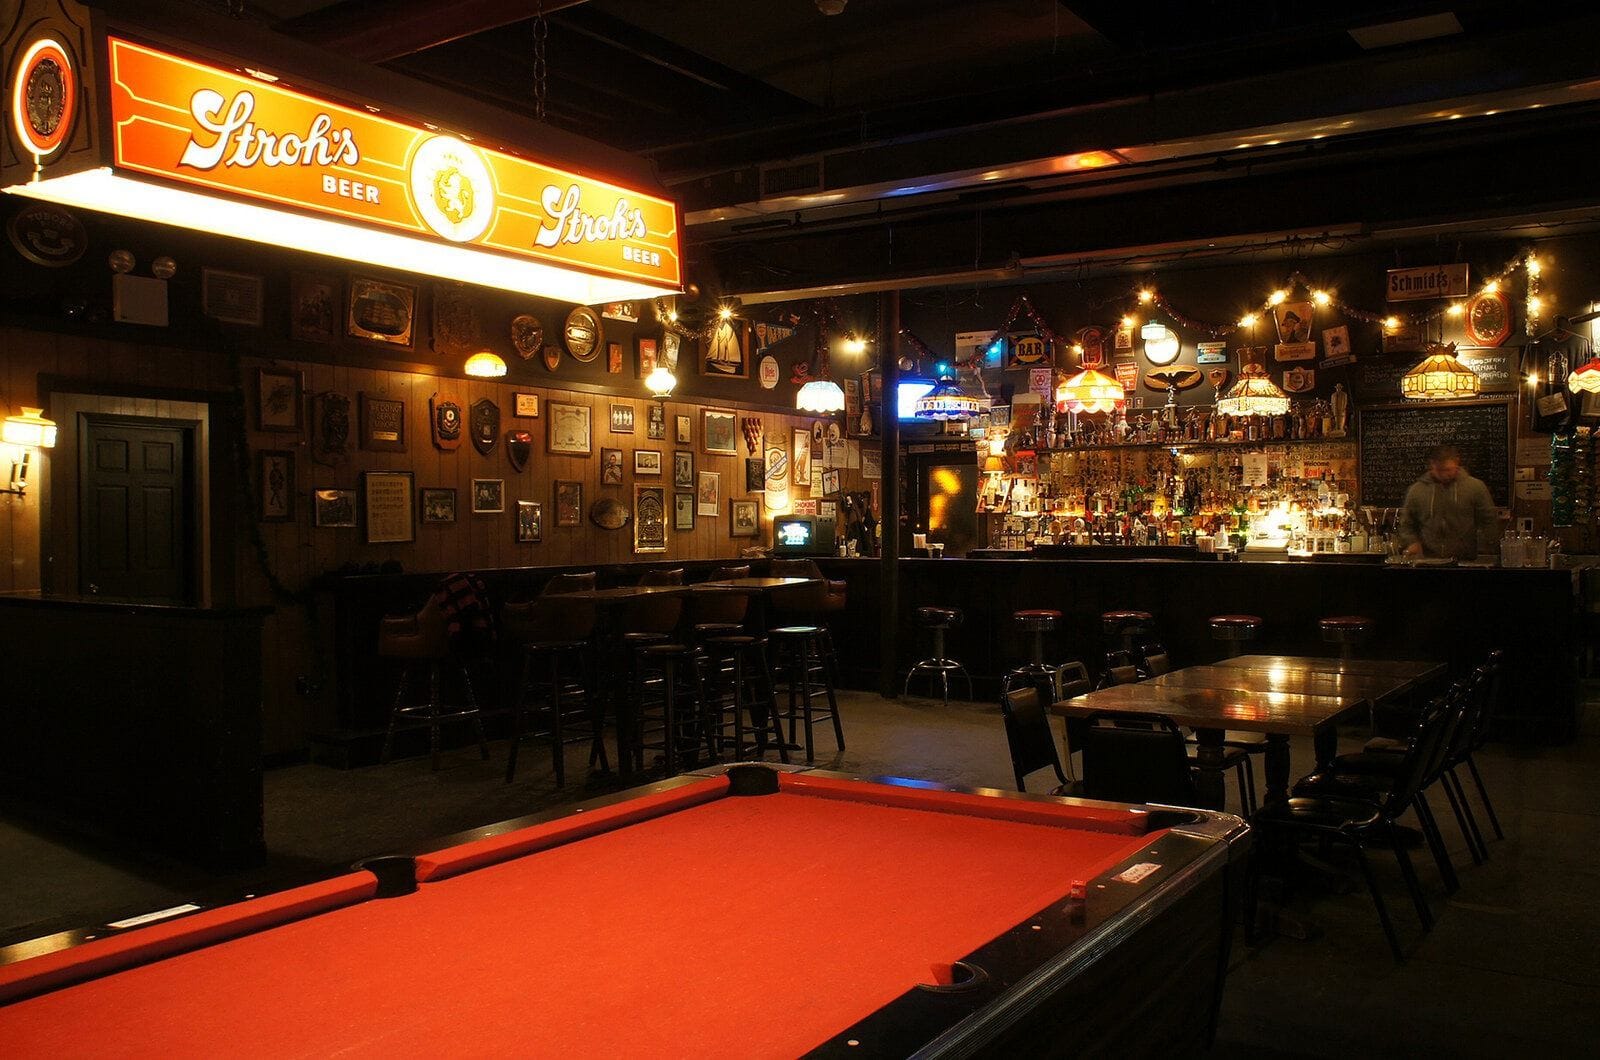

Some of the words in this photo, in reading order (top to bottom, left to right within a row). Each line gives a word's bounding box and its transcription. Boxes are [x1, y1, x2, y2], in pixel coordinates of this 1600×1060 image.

[178, 88, 360, 171] Stroh's
[322, 174, 380, 204] BEER
[534, 183, 647, 247] Stroh's
[622, 245, 661, 267] BEER
[1391, 271, 1449, 292] Schmidt's
[1017, 342, 1043, 357] BAR
